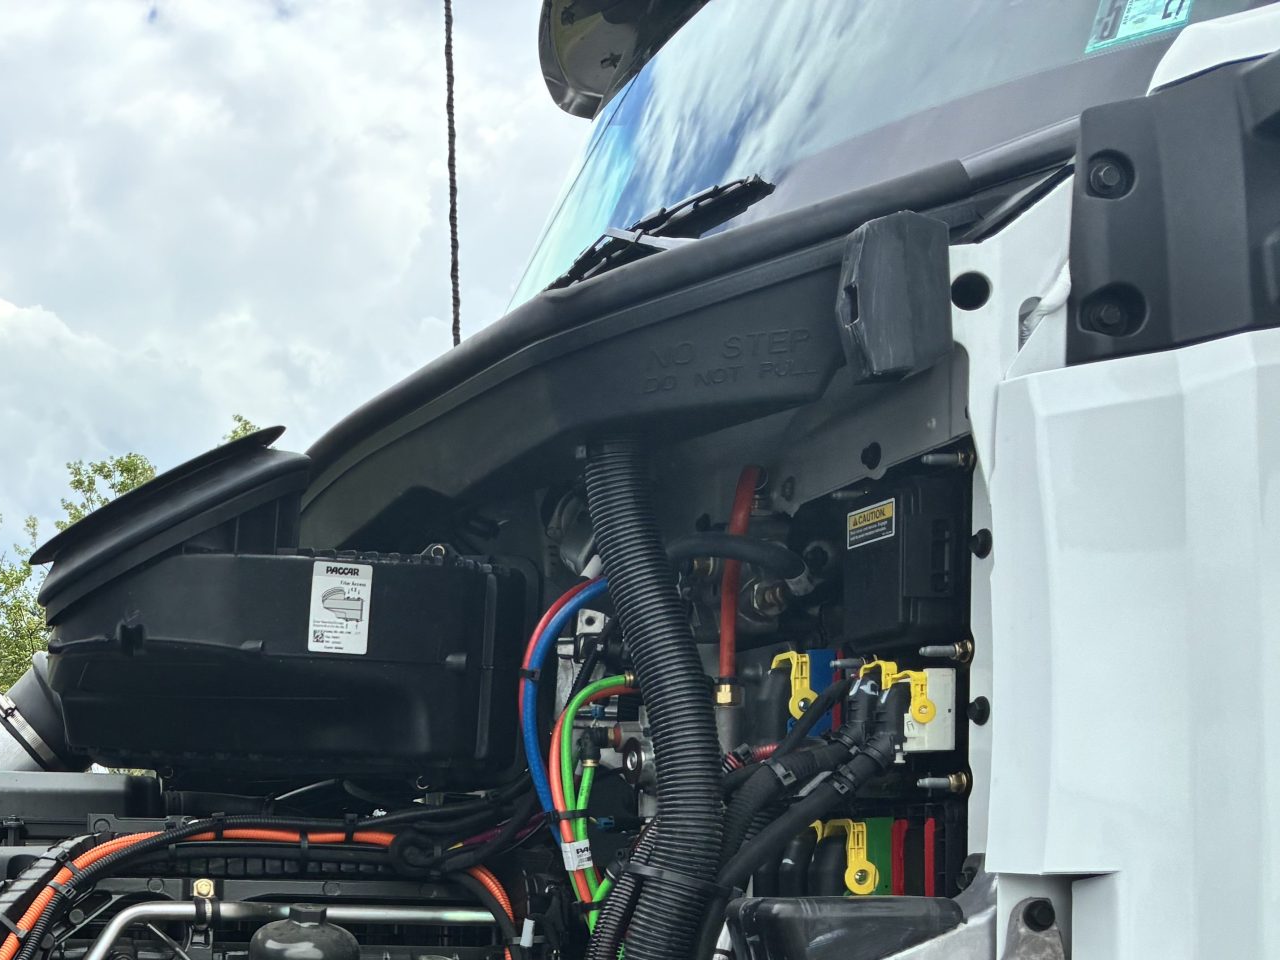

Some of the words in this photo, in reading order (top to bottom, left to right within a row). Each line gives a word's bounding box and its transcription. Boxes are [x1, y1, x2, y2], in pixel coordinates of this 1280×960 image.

[649, 341, 695, 369] NO
[721, 328, 810, 360] STEP
[695, 365, 744, 387] NOT
[326, 566, 360, 576] PACCAR
